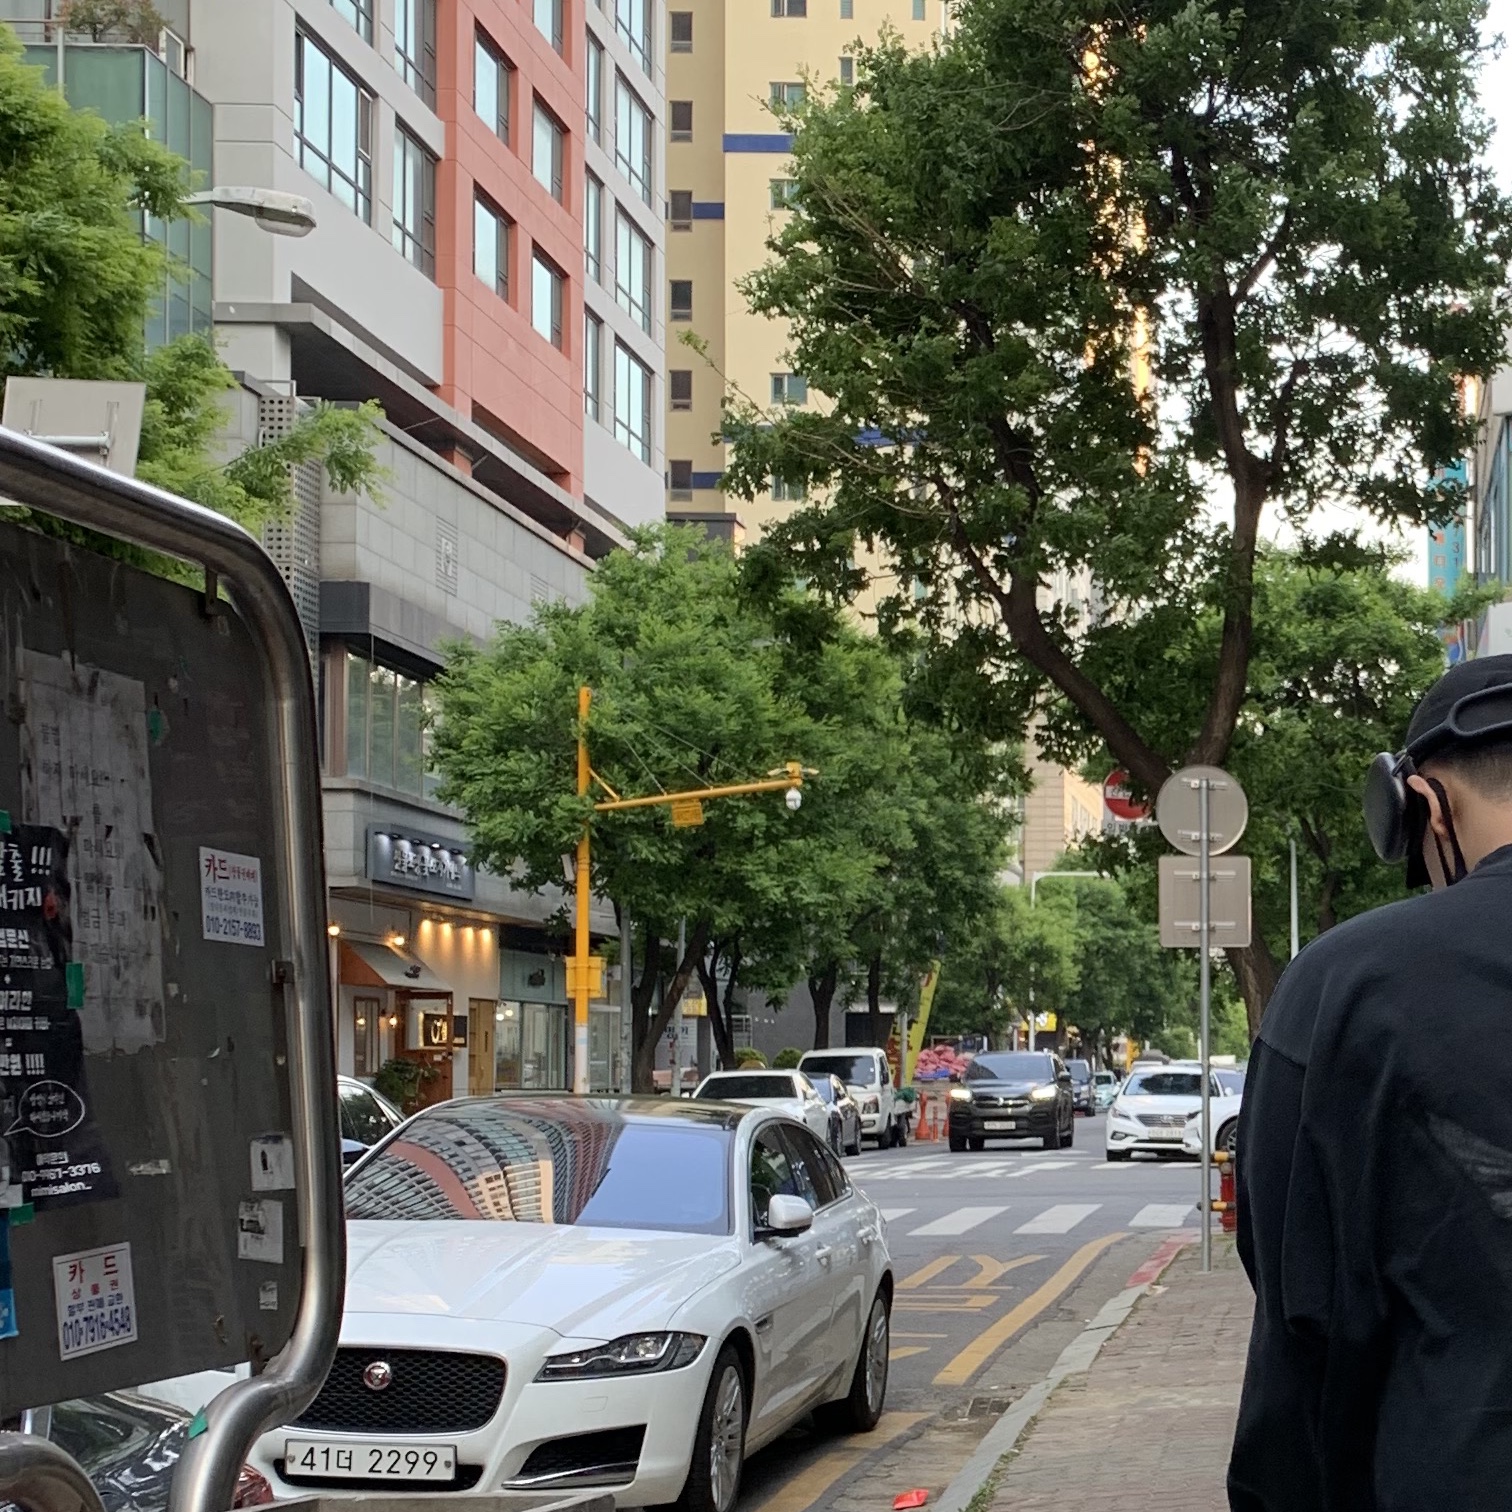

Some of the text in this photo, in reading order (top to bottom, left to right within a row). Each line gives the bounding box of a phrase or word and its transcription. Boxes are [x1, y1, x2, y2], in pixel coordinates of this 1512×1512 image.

[204, 853, 230, 883] 카드
[300, 1446, 438, 1475] 41더 2299
